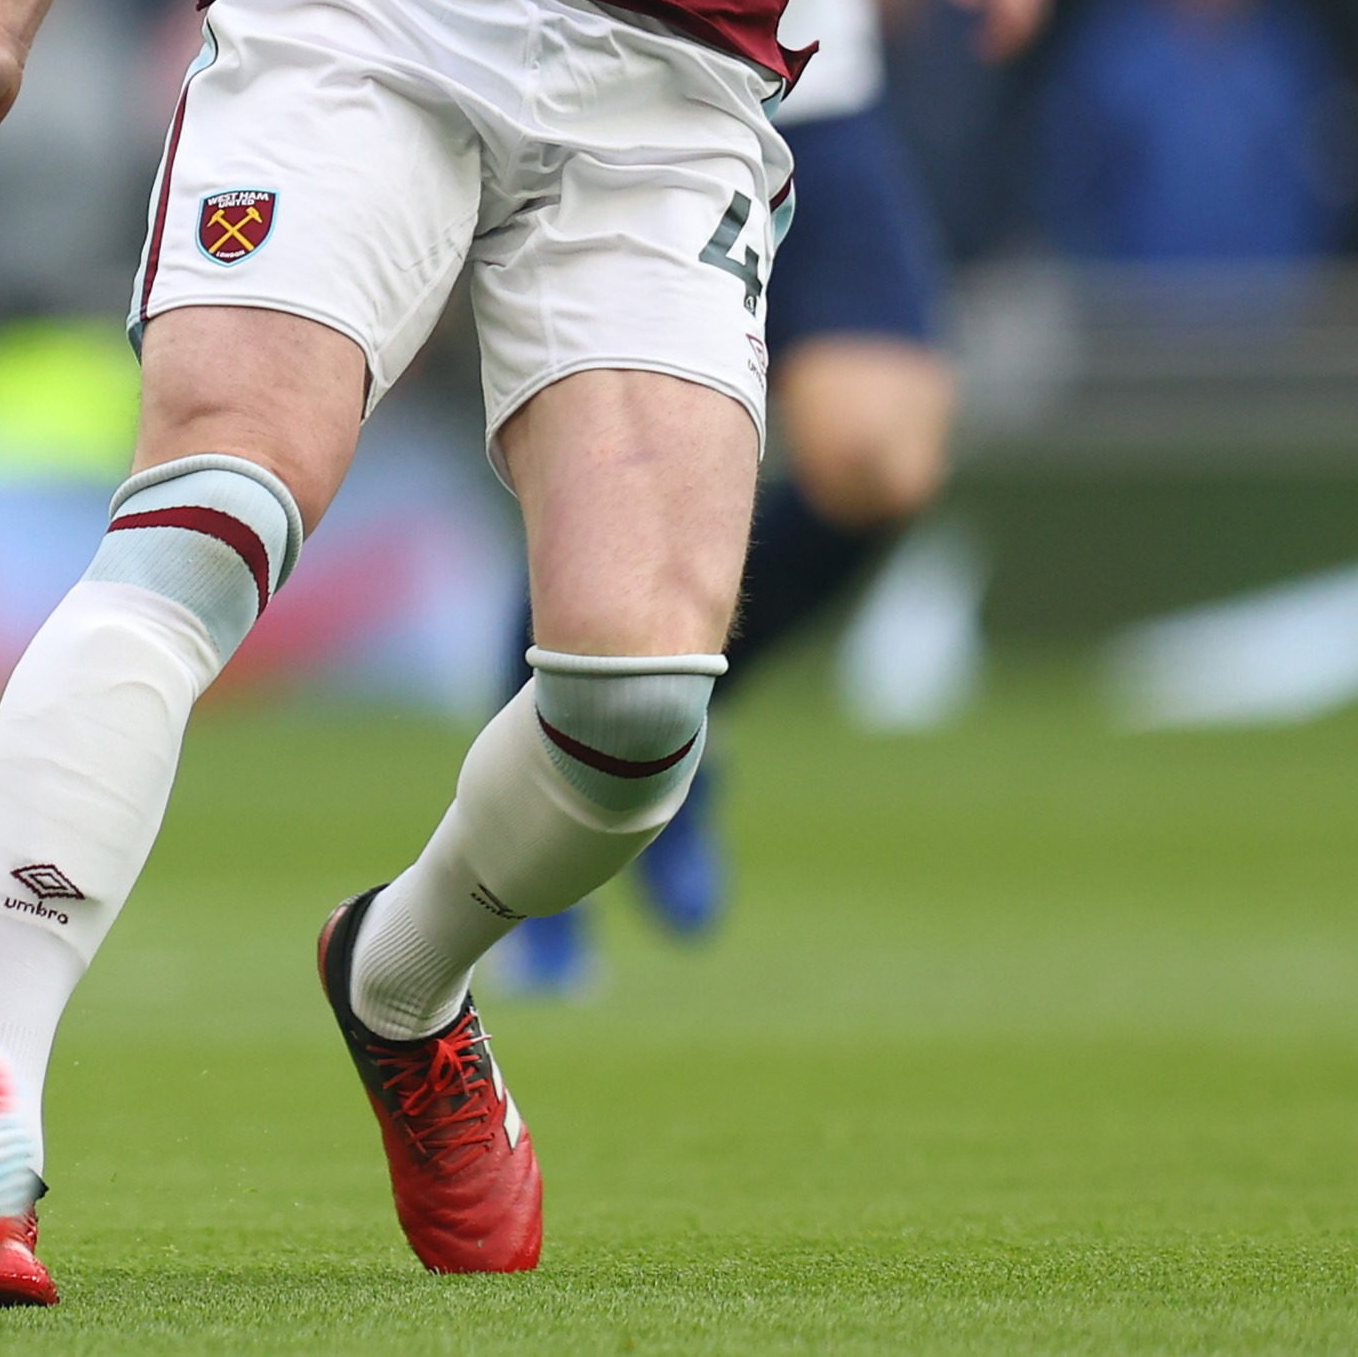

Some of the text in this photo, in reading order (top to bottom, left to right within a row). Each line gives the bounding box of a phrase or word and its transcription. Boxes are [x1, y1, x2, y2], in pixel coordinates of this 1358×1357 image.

[208, 191, 269, 206] WEST HAM
[218, 199, 255, 209] UNITED
[216, 249, 245, 259] LONDON
[698, 189, 763, 318] 4
[4, 897, 69, 925] umbro
